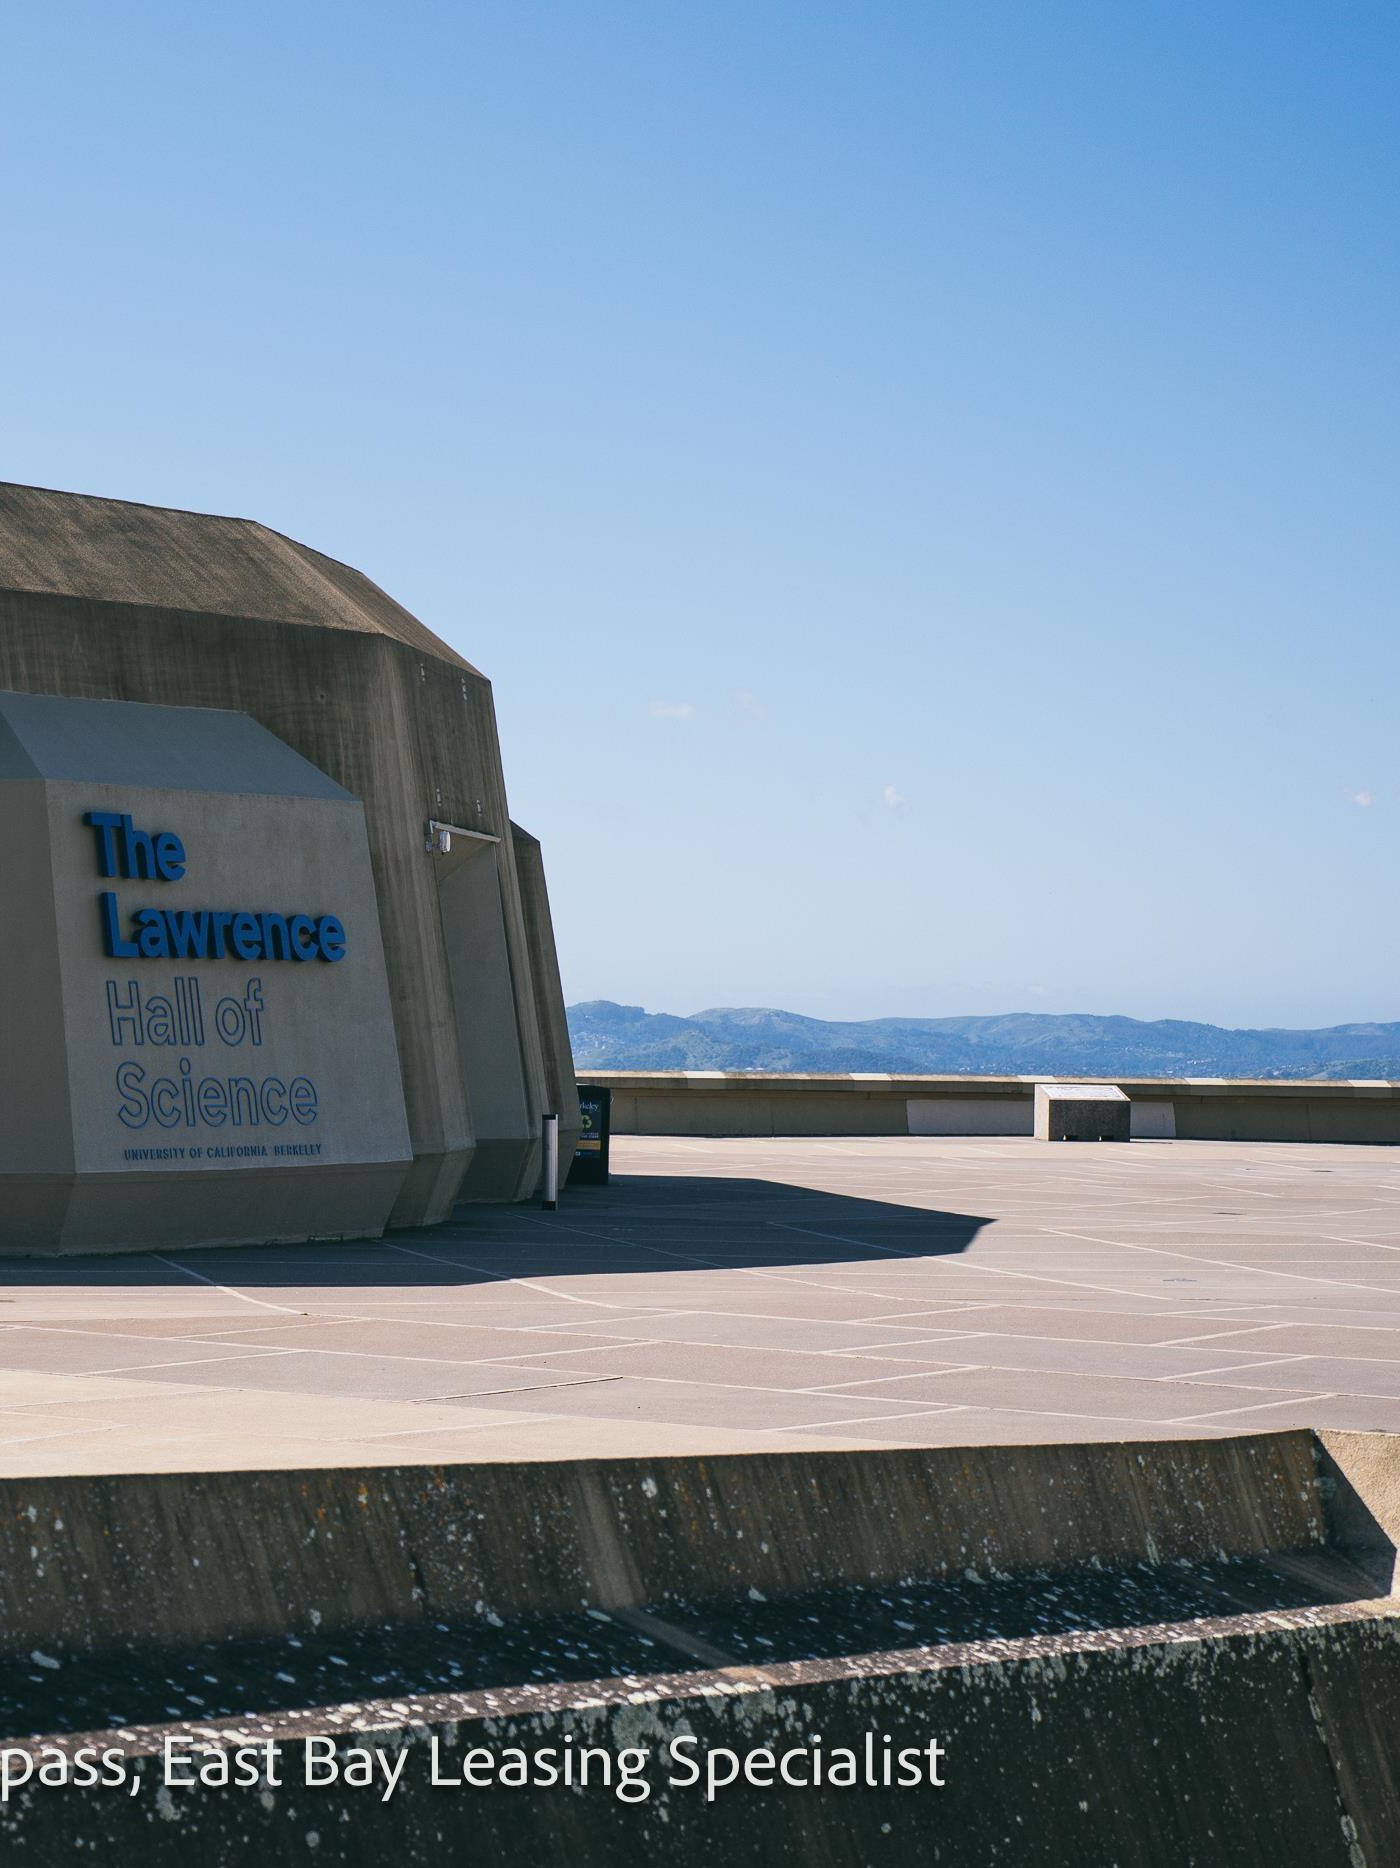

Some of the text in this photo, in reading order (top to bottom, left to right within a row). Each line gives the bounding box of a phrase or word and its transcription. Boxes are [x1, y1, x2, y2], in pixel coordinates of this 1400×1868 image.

[83, 811, 187, 882] The
[100, 891, 347, 962] Lawrence
[106, 976, 264, 1047] Hall of
[115, 1057, 318, 1129] Science
[123, 1143, 322, 1161] UNIVERSITY OF CALIFORNIA BERKELEY
